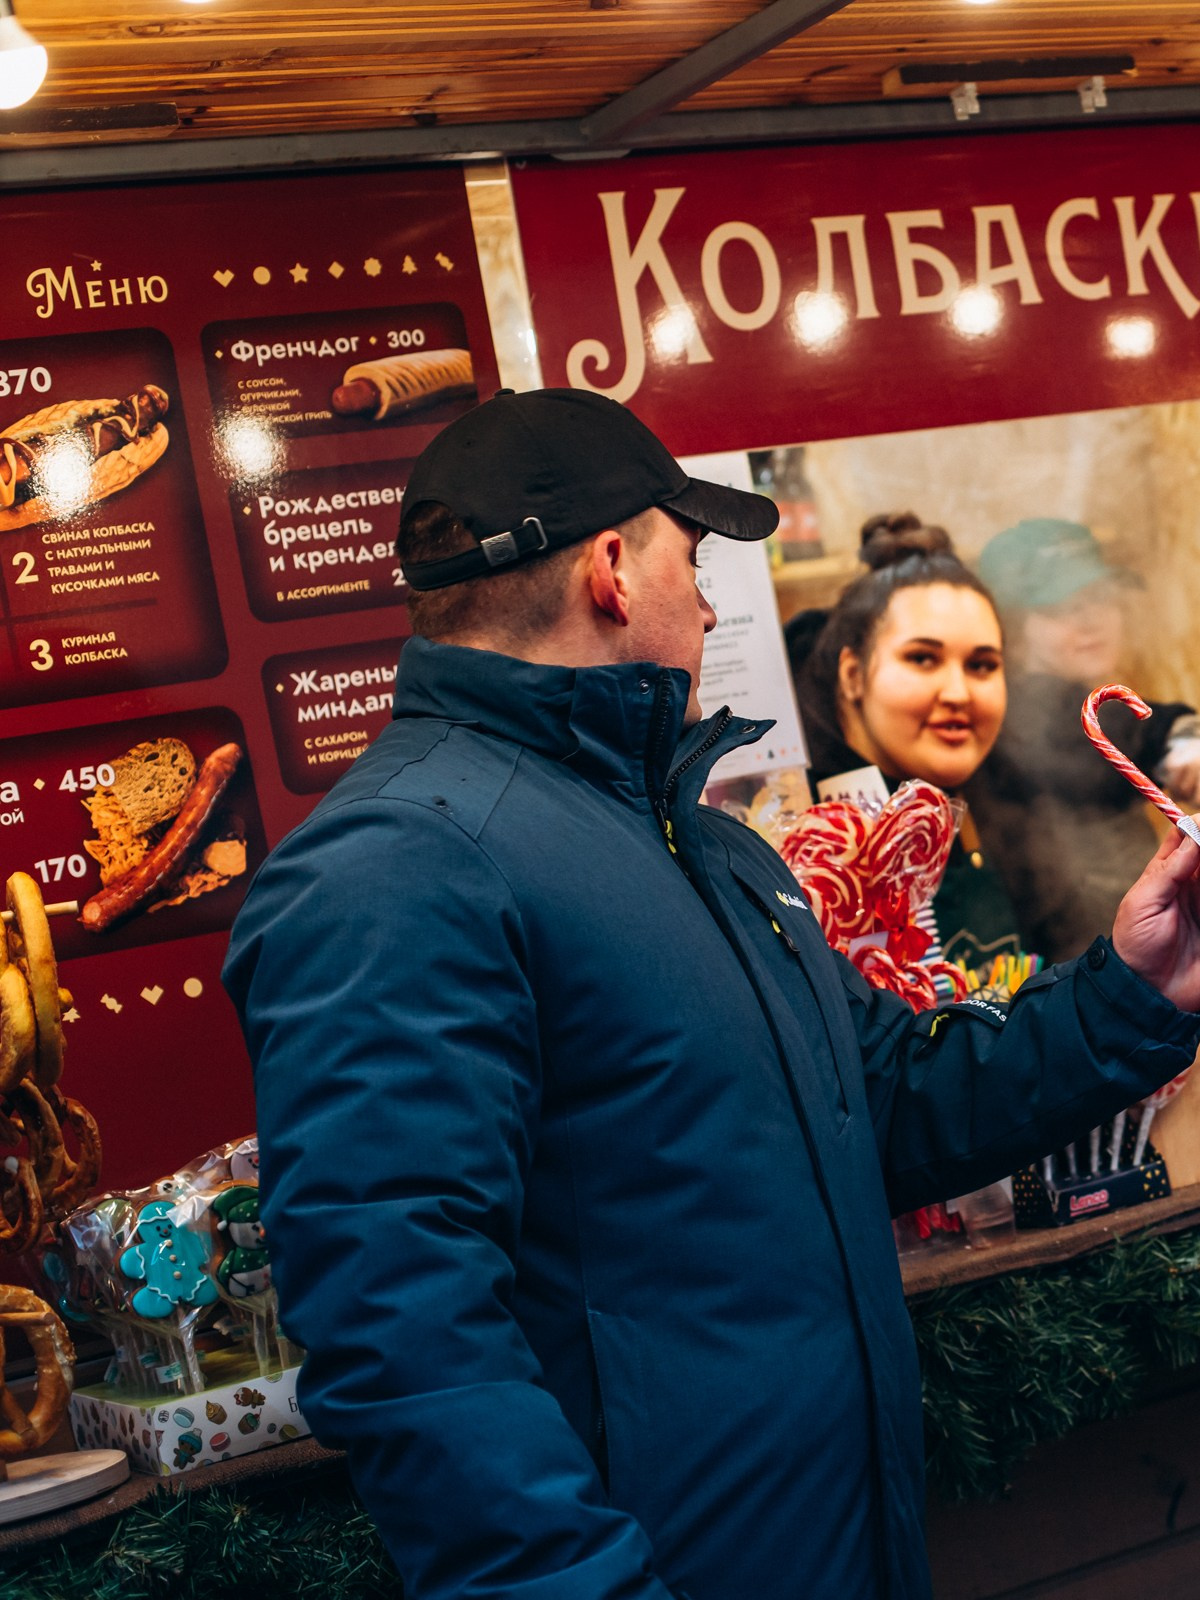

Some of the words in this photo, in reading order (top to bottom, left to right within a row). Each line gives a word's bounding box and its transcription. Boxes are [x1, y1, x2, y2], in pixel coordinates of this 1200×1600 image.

[230, 338, 360, 367] Френчдог
[387, 329, 425, 348] 300
[304, 410, 332, 420] ГРИЛЬ
[42, 528, 90, 544] СВИНАЯ
[92, 522, 155, 538] КОЛБАСКА
[263, 518, 373, 550] брецель
[45, 551, 54, 561] С
[56, 539, 151, 560] НАТУРАЛЬНЫМИ
[12, 551, 39, 584] 2
[47, 561, 103, 577] ТРАВАМИ
[105, 560, 115, 570] И
[269, 555, 285, 573] и
[51, 575, 125, 594] КУСОЧКАМИ
[127, 571, 160, 585] МЯСА
[276, 591, 285, 602] В
[287, 579, 370, 600] АССОРТИМЕНТЕ
[61, 631, 116, 649] КУРИНАЯ
[29, 639, 54, 671] 3
[64, 647, 128, 665] КОЛБАСКА
[304, 738, 313, 749] С
[314, 731, 368, 748] САХАРОМ
[307, 754, 317, 765] И
[58, 763, 115, 792] 450
[34, 854, 87, 883] 170
